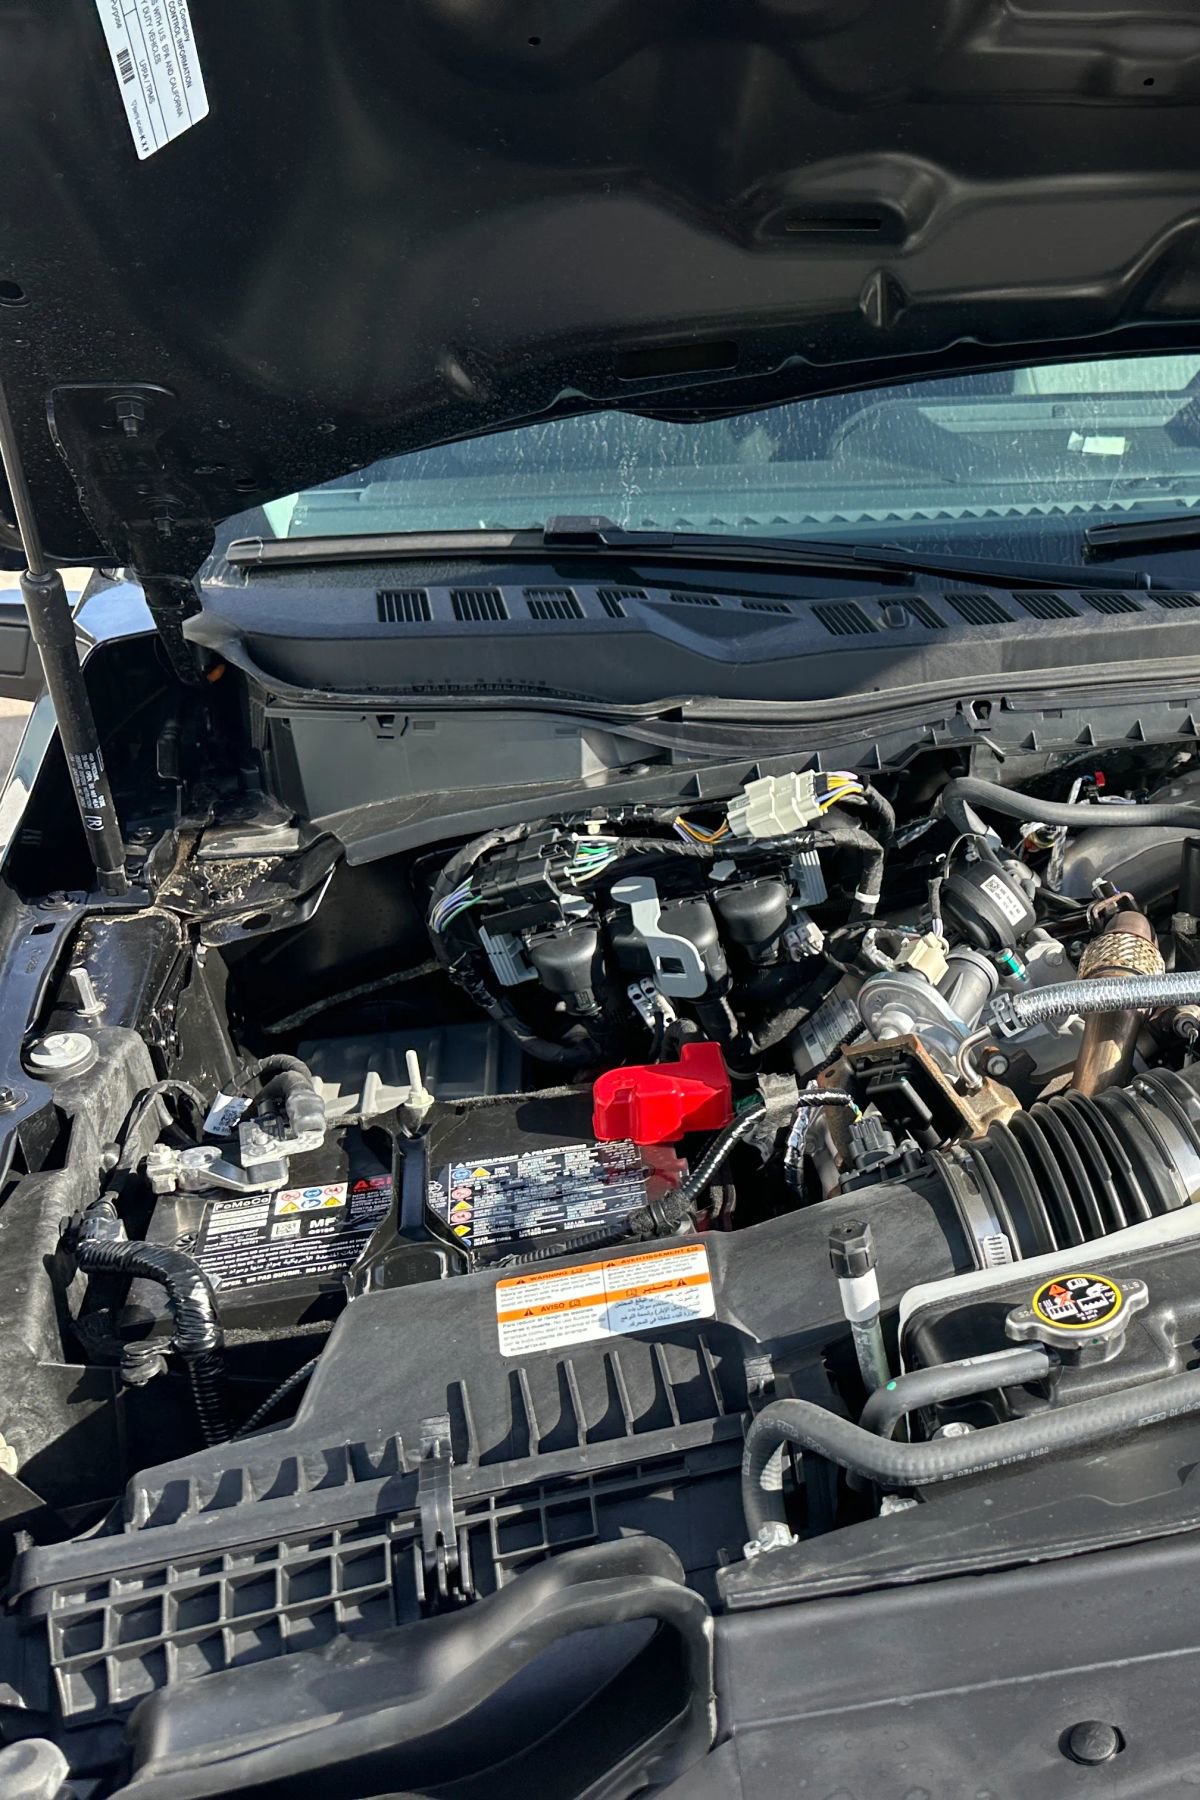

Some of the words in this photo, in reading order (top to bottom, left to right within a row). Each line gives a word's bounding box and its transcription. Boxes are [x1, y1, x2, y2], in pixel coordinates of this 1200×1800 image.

[152, 6, 162, 27] WITH
[178, 8, 190, 42] Company
[142, 7, 152, 29] DUTY
[148, 29, 162, 65] VEHICLES
[168, 0, 180, 38] CONTROL
[176, 38, 193, 88] INFORMATION
[165, 60, 174, 76] AND
[168, 77, 184, 118] CALIFORNIA
[84, 815, 104, 831] (R)
[215, 1197, 268, 1210] FoMoCo
[310, 1217, 336, 1228] MF
[620, 1250, 684, 1264] AVERTISSEMENT
[530, 1271, 568, 1280] WARNING
[540, 1302, 564, 1312] AVISO
